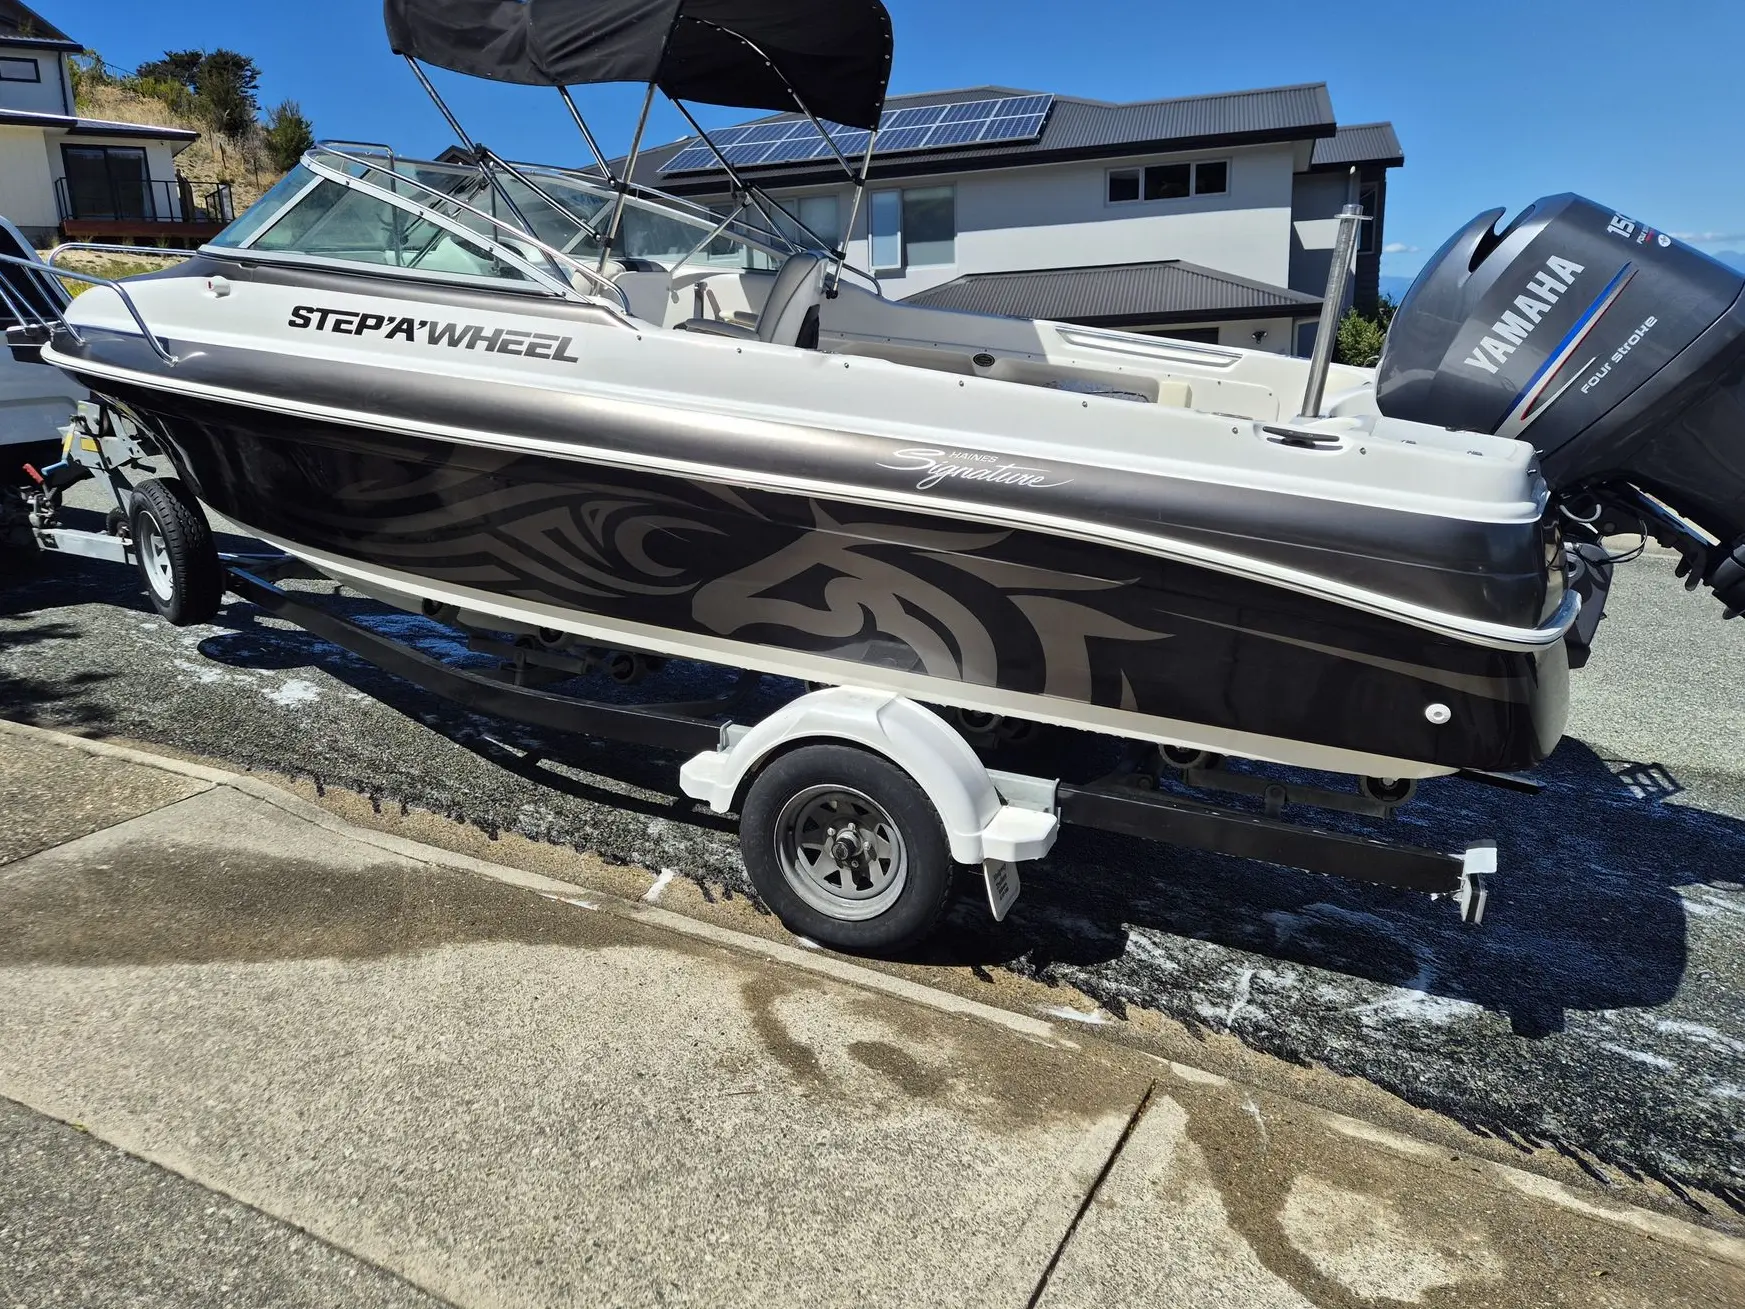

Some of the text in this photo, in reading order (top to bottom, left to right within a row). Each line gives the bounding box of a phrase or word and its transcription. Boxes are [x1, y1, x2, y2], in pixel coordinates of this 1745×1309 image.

[1464, 254, 1586, 375] YAMAHA
[875, 448, 1075, 490] Signature
[949, 451, 999, 463] HAINES
